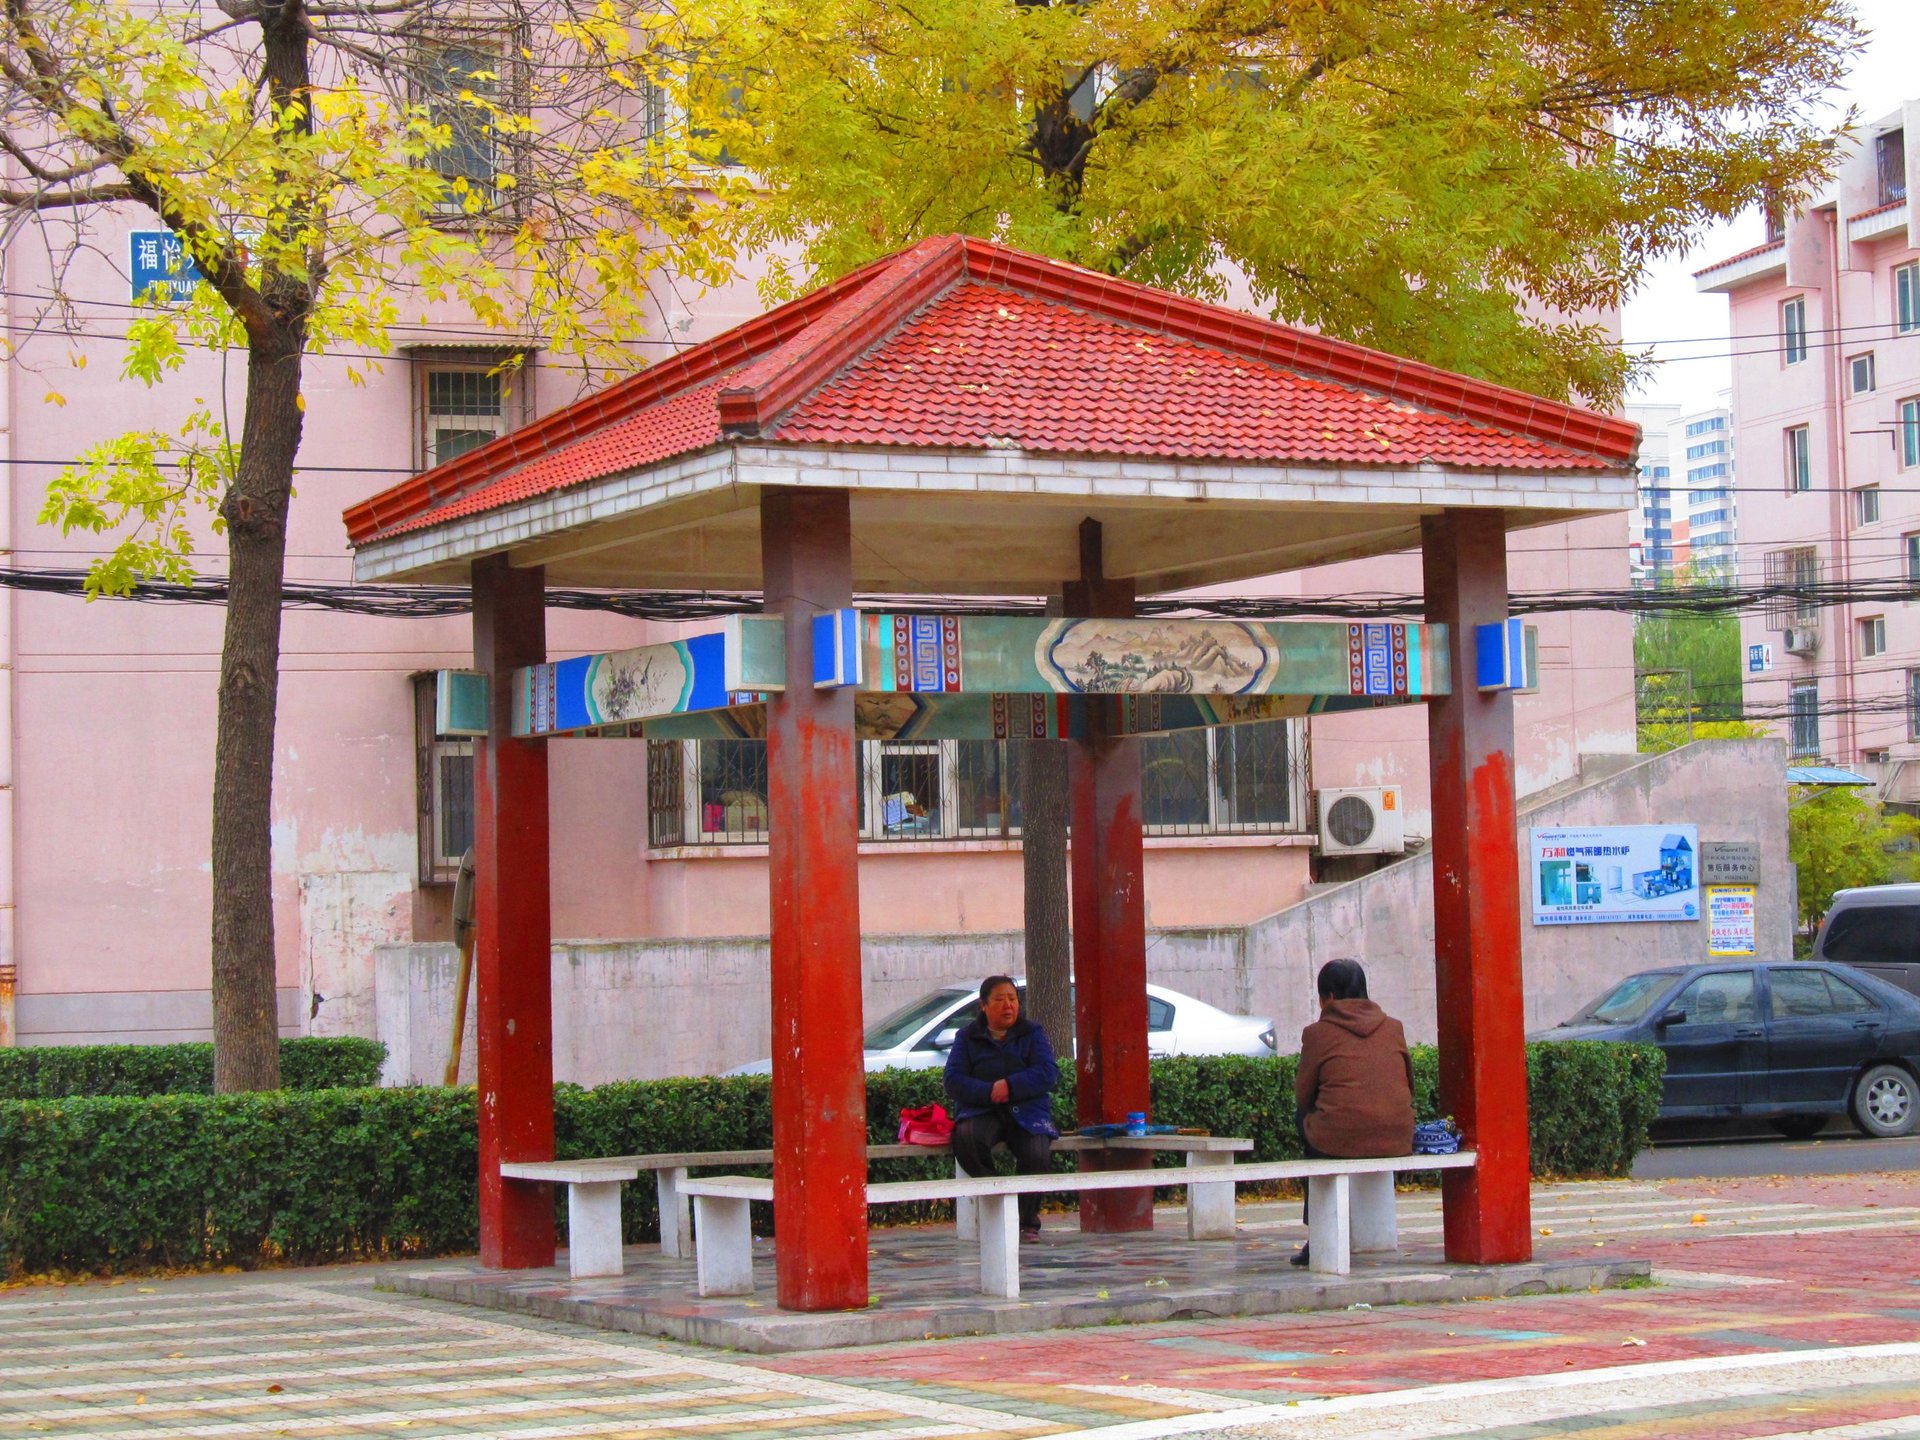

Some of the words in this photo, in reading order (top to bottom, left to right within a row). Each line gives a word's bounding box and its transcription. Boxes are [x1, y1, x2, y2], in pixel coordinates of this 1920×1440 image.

[138, 239, 195, 270] 福怡
[1707, 863, 1755, 872] 售后服务中心
